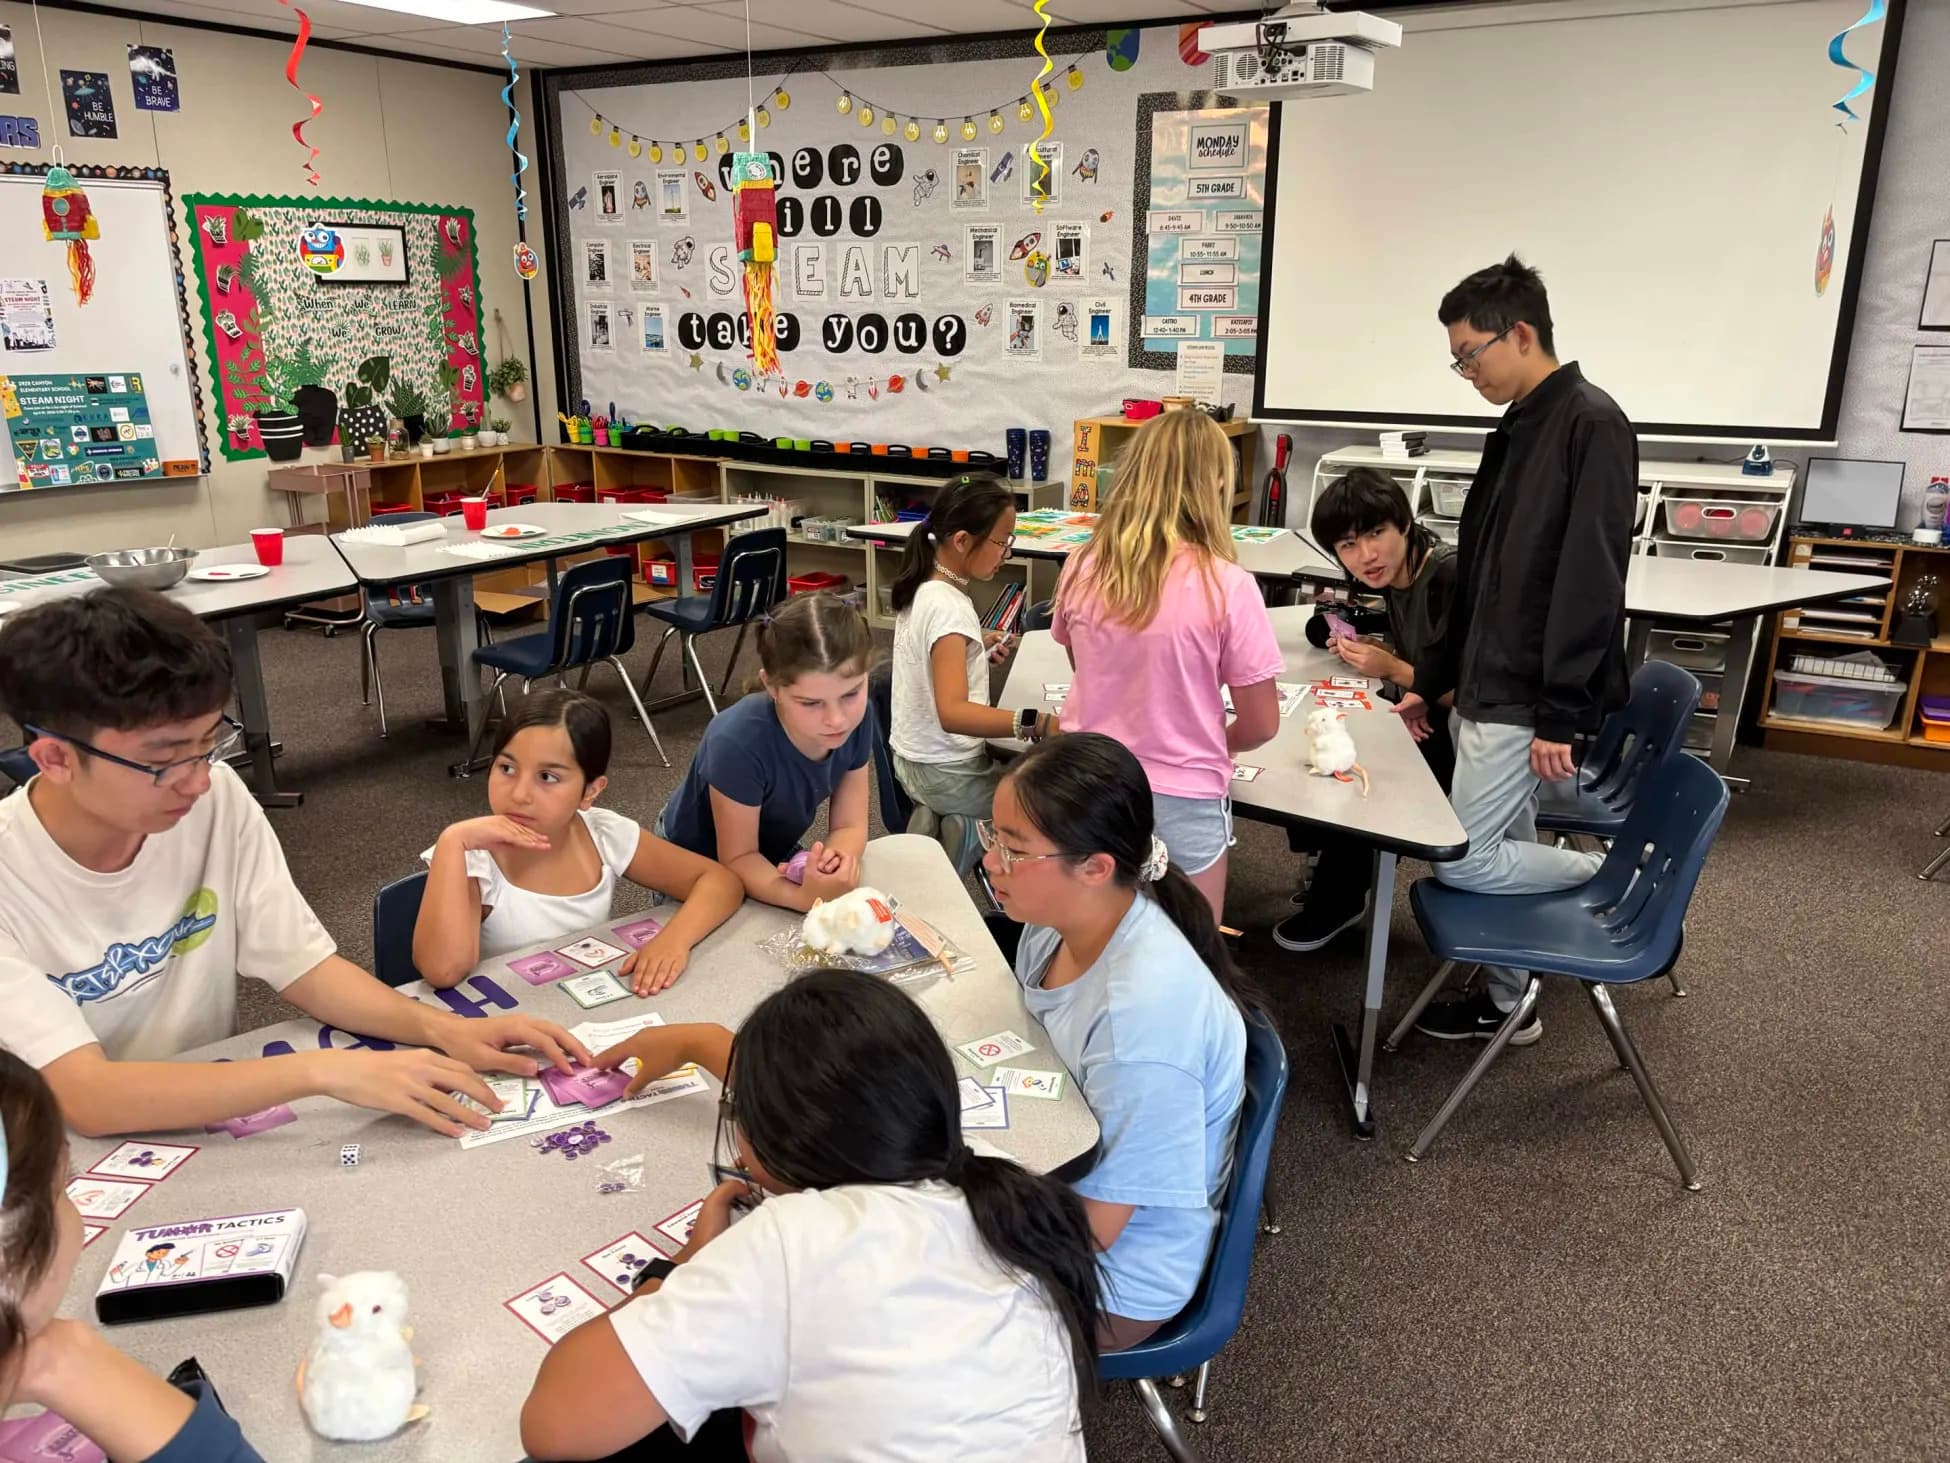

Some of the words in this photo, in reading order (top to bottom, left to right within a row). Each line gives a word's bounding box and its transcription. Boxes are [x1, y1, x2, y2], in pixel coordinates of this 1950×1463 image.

[152, 85, 162, 95] BE
[92, 101, 104, 112] BE
[145, 95, 171, 107] BRAVE
[84, 112, 113, 122] HUMBLE
[1197, 135, 1239, 149] MONDAY
[1198, 147, 1235, 158] schedule
[1196, 184, 1209, 193] 5TH
[1211, 183, 1235, 193] GRADE
[709, 245, 920, 298] SEAM
[1189, 294, 1201, 303] 4TH
[1203, 294, 1227, 303] GRADE
[303, 299, 333, 310] When
[354, 300, 369, 309] We
[389, 300, 416, 310] LEARN
[332, 328, 347, 337] We
[375, 327, 401, 337] GROW
[827, 316, 959, 350] you?
[20, 396, 54, 405] STEAM
[54, 395, 85, 404] NIGHT
[216, 1215, 286, 1231] TACTICS
